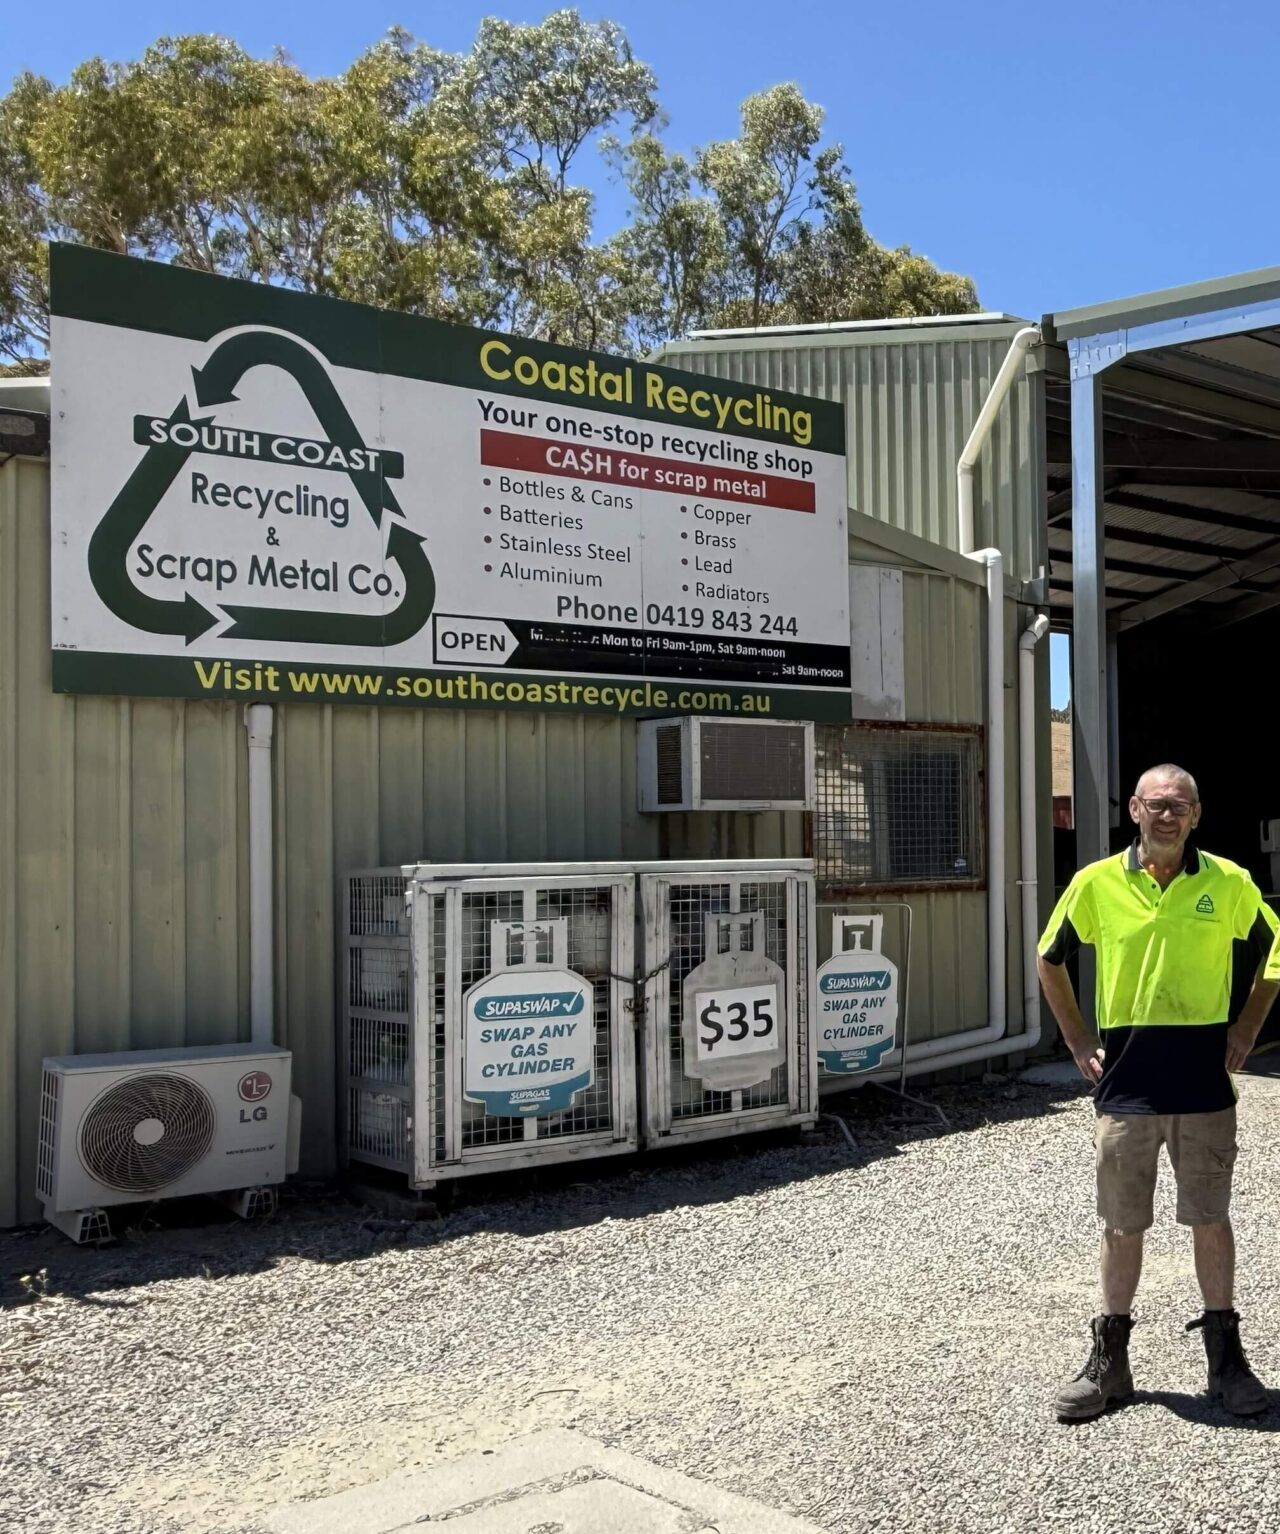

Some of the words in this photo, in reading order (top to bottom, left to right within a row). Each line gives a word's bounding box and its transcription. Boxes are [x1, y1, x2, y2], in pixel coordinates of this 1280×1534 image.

[480, 340, 632, 404] Coastal
[646, 372, 812, 445] Recycling
[150, 419, 260, 455] SOUTH
[271, 438, 379, 472] COAST
[477, 398, 538, 428] Your
[546, 416, 654, 452] one-stop
[662, 435, 758, 470] recycling
[764, 450, 813, 478] shop
[546, 446, 611, 475] CA$H
[618, 459, 650, 480] for
[655, 469, 707, 492] scrap
[713, 480, 767, 499] metal
[191, 472, 349, 528] Recycling
[500, 476, 565, 500] Bottles
[571, 486, 585, 503] &
[591, 489, 633, 510] Cans
[500, 504, 583, 530] Batteries
[694, 504, 752, 526] Copper
[266, 526, 280, 546] &
[695, 530, 736, 549] Brass
[500, 533, 582, 558] Stainless
[587, 543, 631, 563] Steel
[136, 544, 237, 591] Scrap
[248, 554, 338, 592] Metal
[348, 564, 400, 597] Co.
[500, 562, 602, 587] Aluminium
[695, 555, 733, 574] Lead
[696, 582, 769, 604] Radiators
[557, 595, 638, 623] Phone
[646, 603, 704, 628] 0419
[712, 610, 752, 632] 843
[759, 614, 798, 637] 244
[441, 630, 506, 652] OPEN
[602, 633, 628, 646] Mon
[630, 636, 643, 648] to
[646, 637, 660, 649] Fri
[662, 638, 715, 655] 9am-1pm,
[717, 642, 734, 655] Sat
[735, 644, 786, 659] 9am-noon
[782, 663, 796, 675] Sat
[797, 665, 844, 678] 9am-noon
[193, 660, 280, 691] Visit
[288, 671, 770, 712] www.southcoastrecycle.com.au
[827, 975, 876, 990] SUPASWAP
[485, 996, 560, 1016] SUPASWAP
[823, 998, 858, 1012] SWAP
[861, 996, 886, 1009] ANY
[701, 999, 773, 1051] $35
[842, 1012, 867, 1024] GAS
[480, 1026, 535, 1043] SWAP
[539, 1023, 578, 1039] ANY
[823, 1025, 884, 1040] CYLINDER
[511, 1042, 548, 1059] GAS
[482, 1057, 575, 1078] CYLINDER
[239, 1106, 267, 1123] LG
